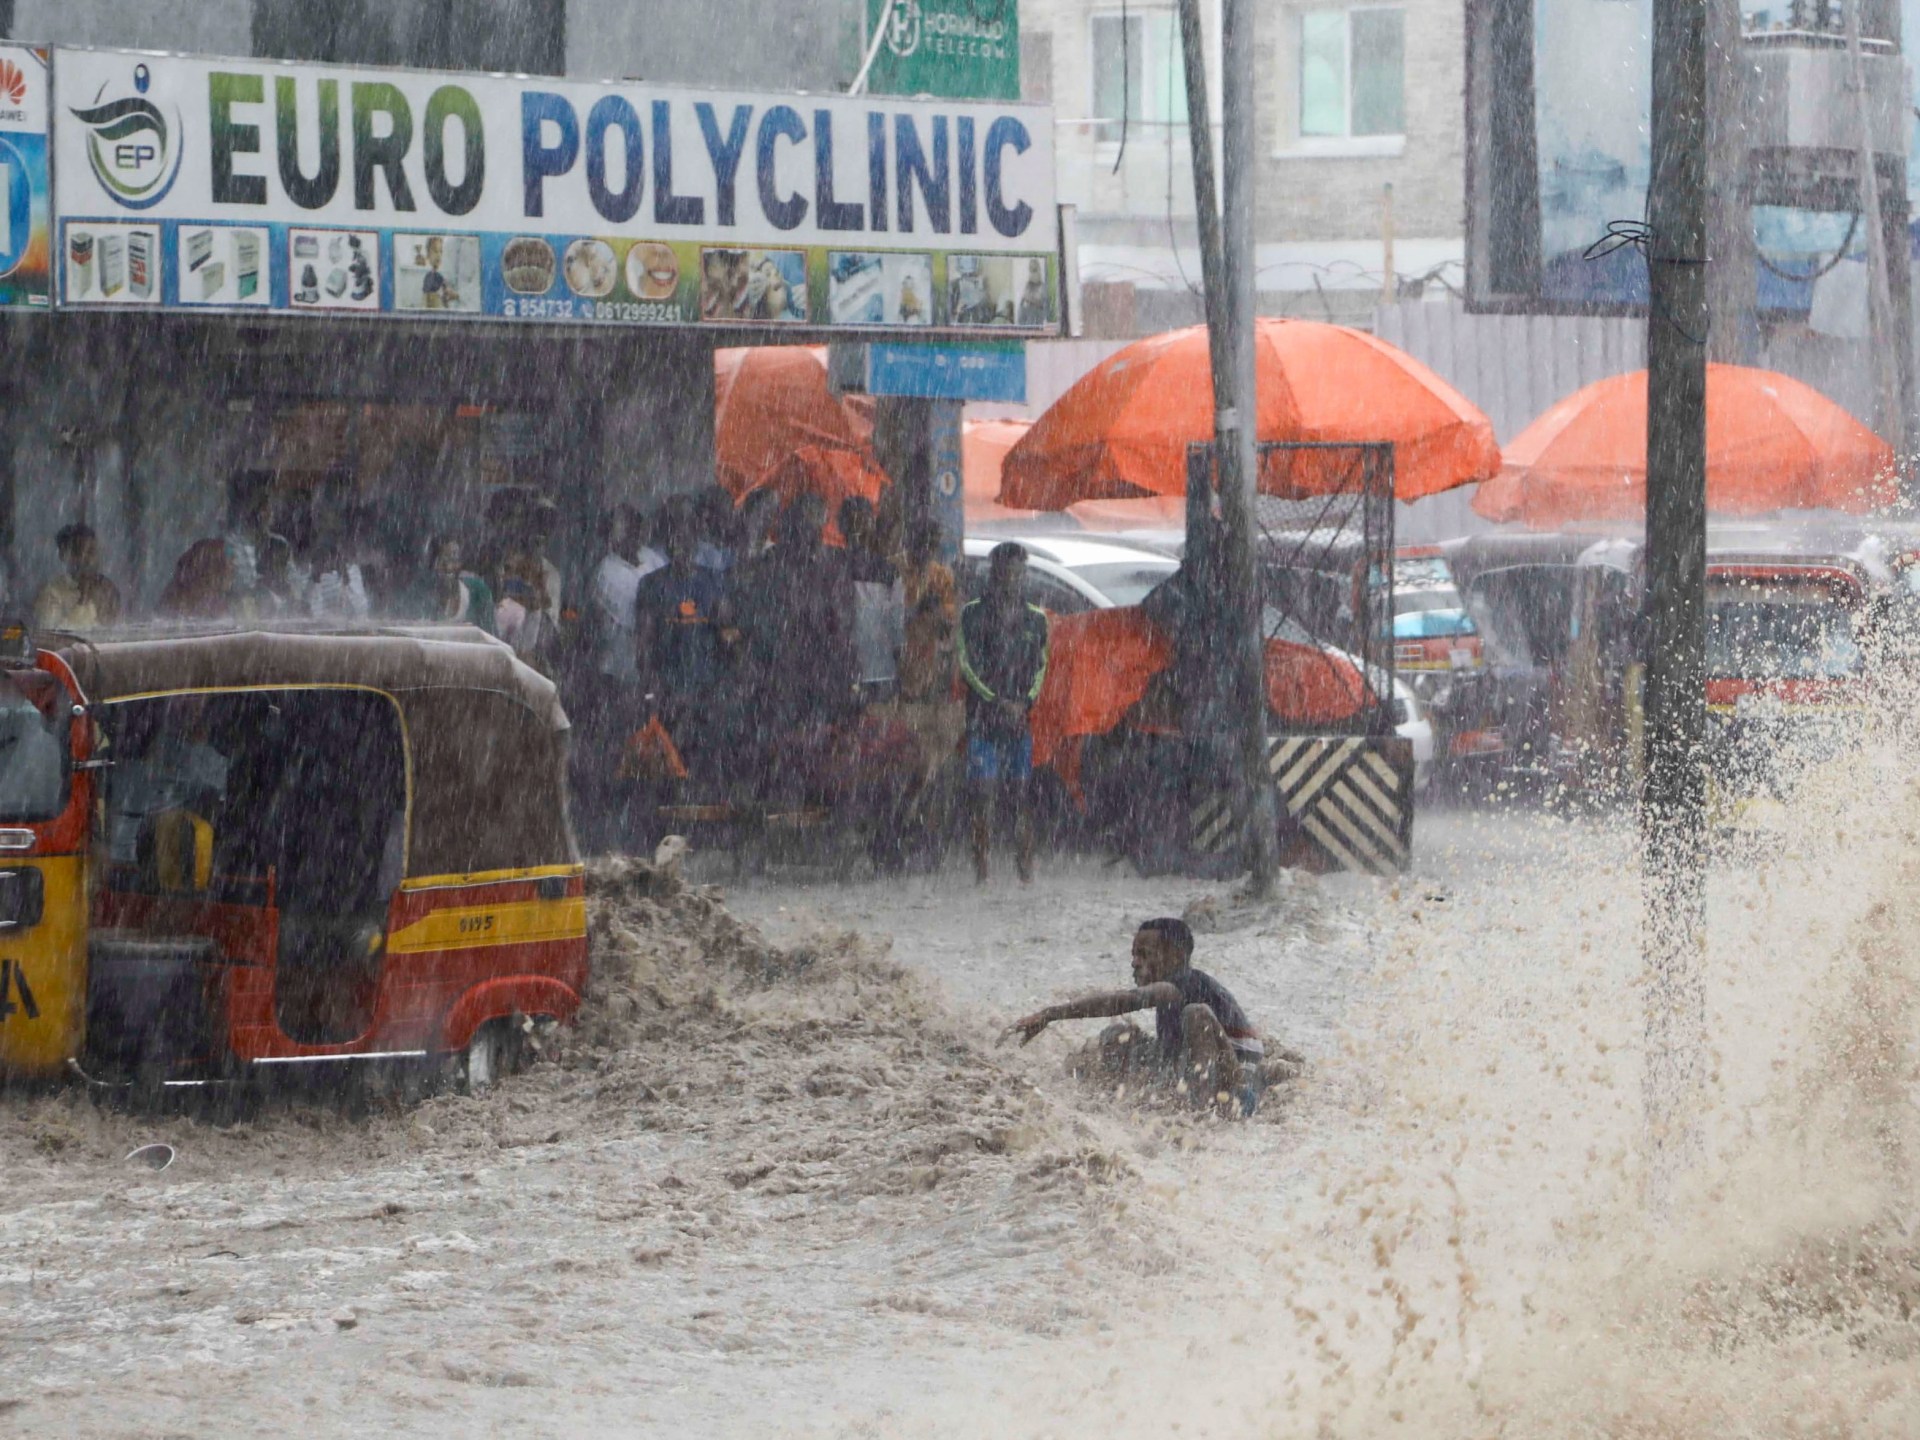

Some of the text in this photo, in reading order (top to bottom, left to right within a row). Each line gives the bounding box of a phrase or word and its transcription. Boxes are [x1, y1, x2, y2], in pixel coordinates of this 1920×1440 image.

[924, 36, 1006, 59] TELECOM
[115, 142, 155, 169] EP
[208, 71, 1033, 238] EURO POLYCLINIC
